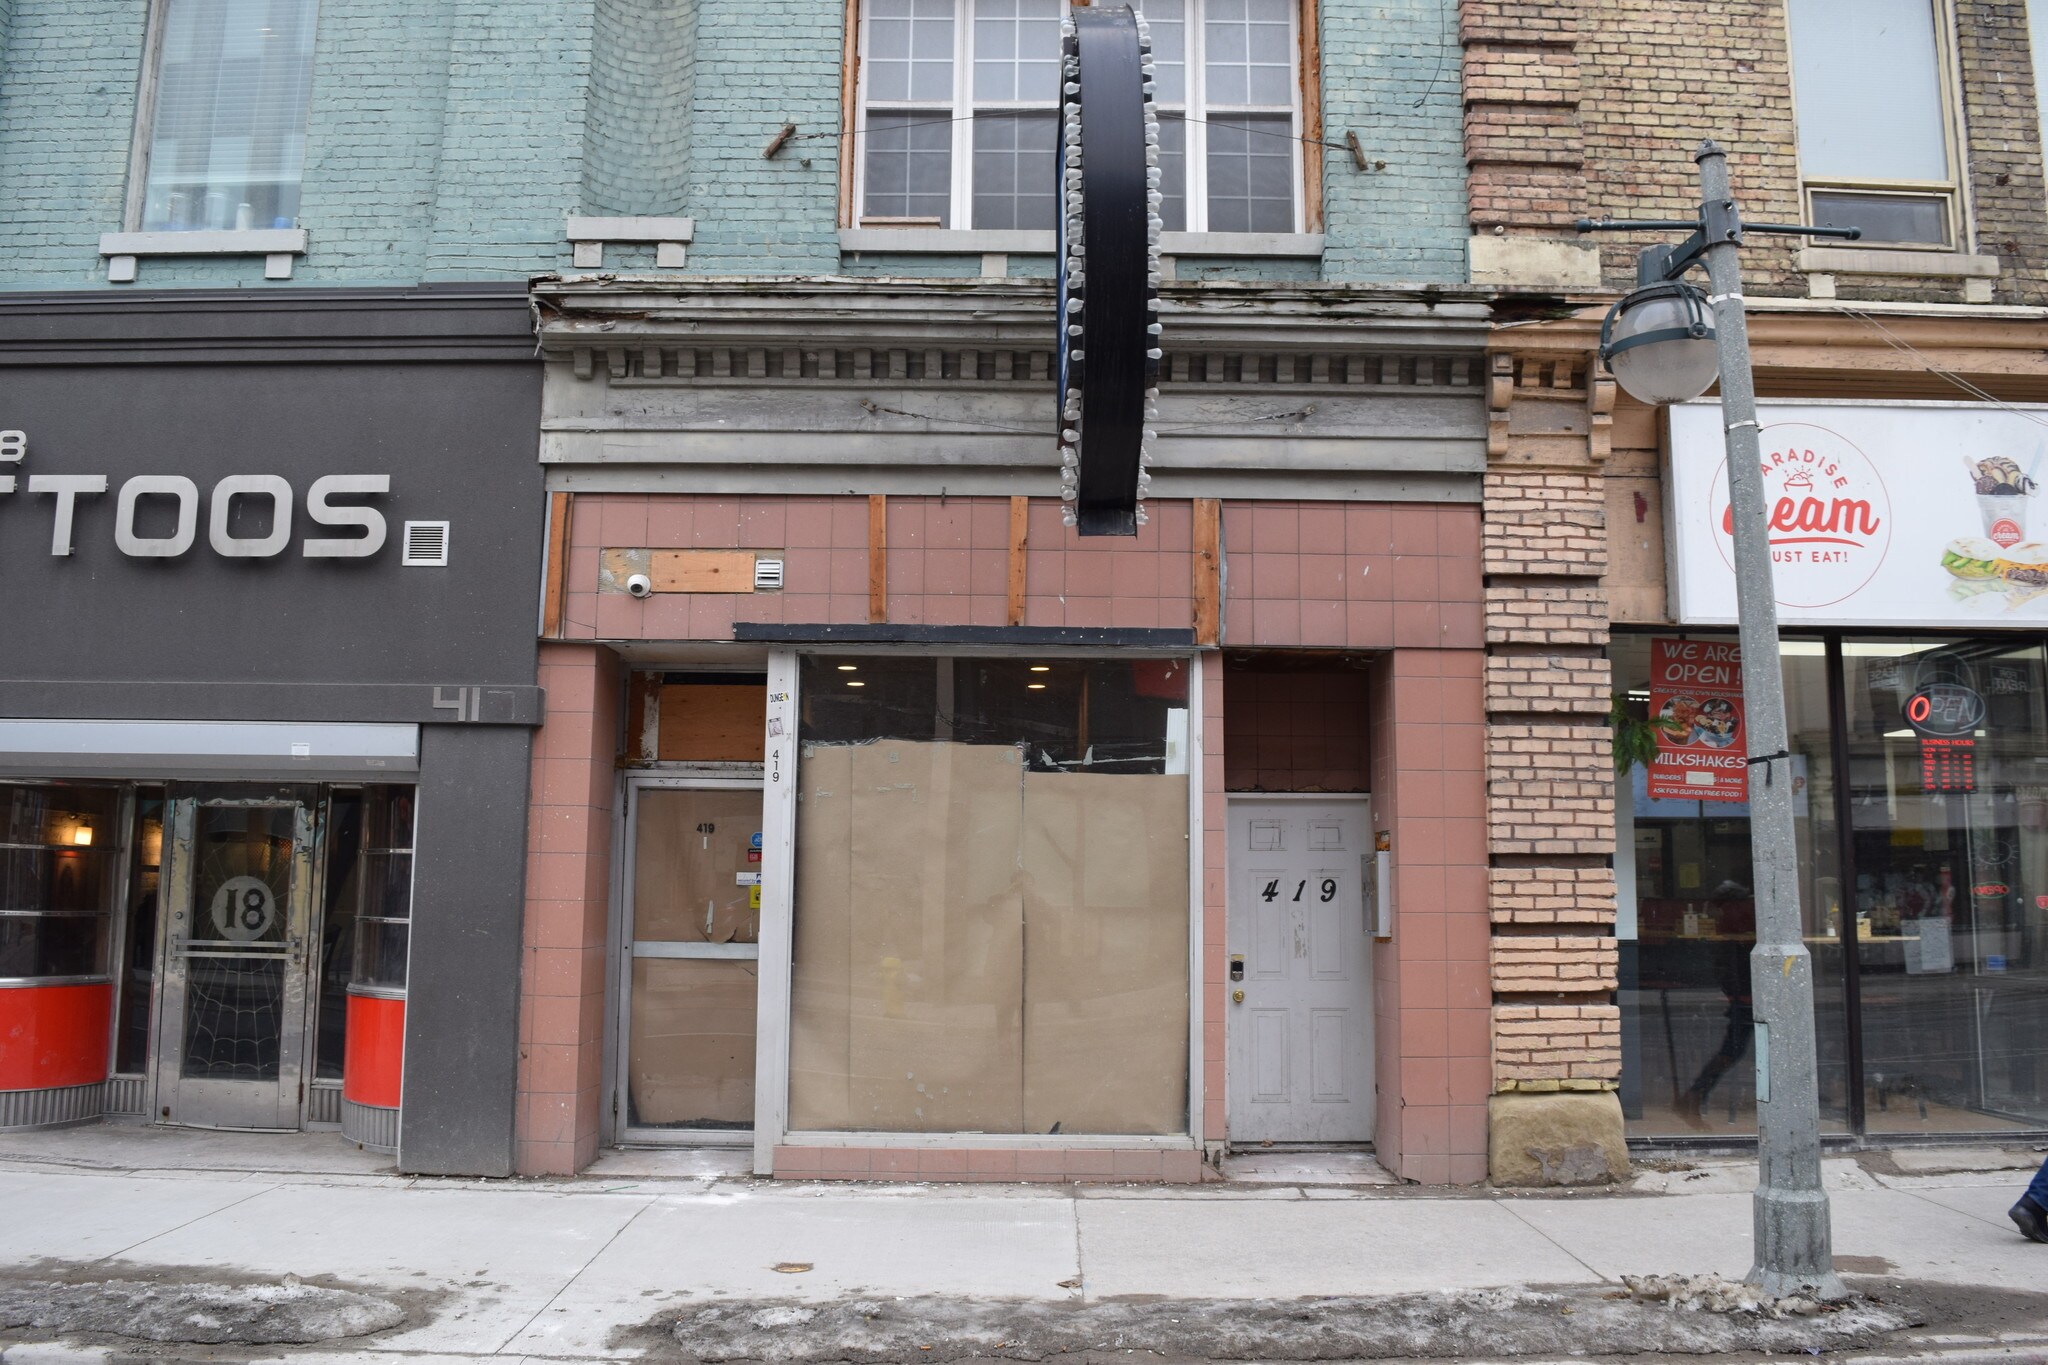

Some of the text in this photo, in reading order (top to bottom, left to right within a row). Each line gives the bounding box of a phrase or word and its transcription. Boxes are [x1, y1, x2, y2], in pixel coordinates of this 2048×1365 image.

[1760, 448, 1847, 489] ARADISE
[0, 474, 390, 557] TOOS
[1772, 551, 1848, 562] UST EAT!
[1663, 642, 1742, 662] WE ARE
[1665, 663, 1729, 685] OPEN
[1909, 696, 1978, 722] OPEN
[696, 823, 715, 834] 419
[224, 888, 266, 930] 18
